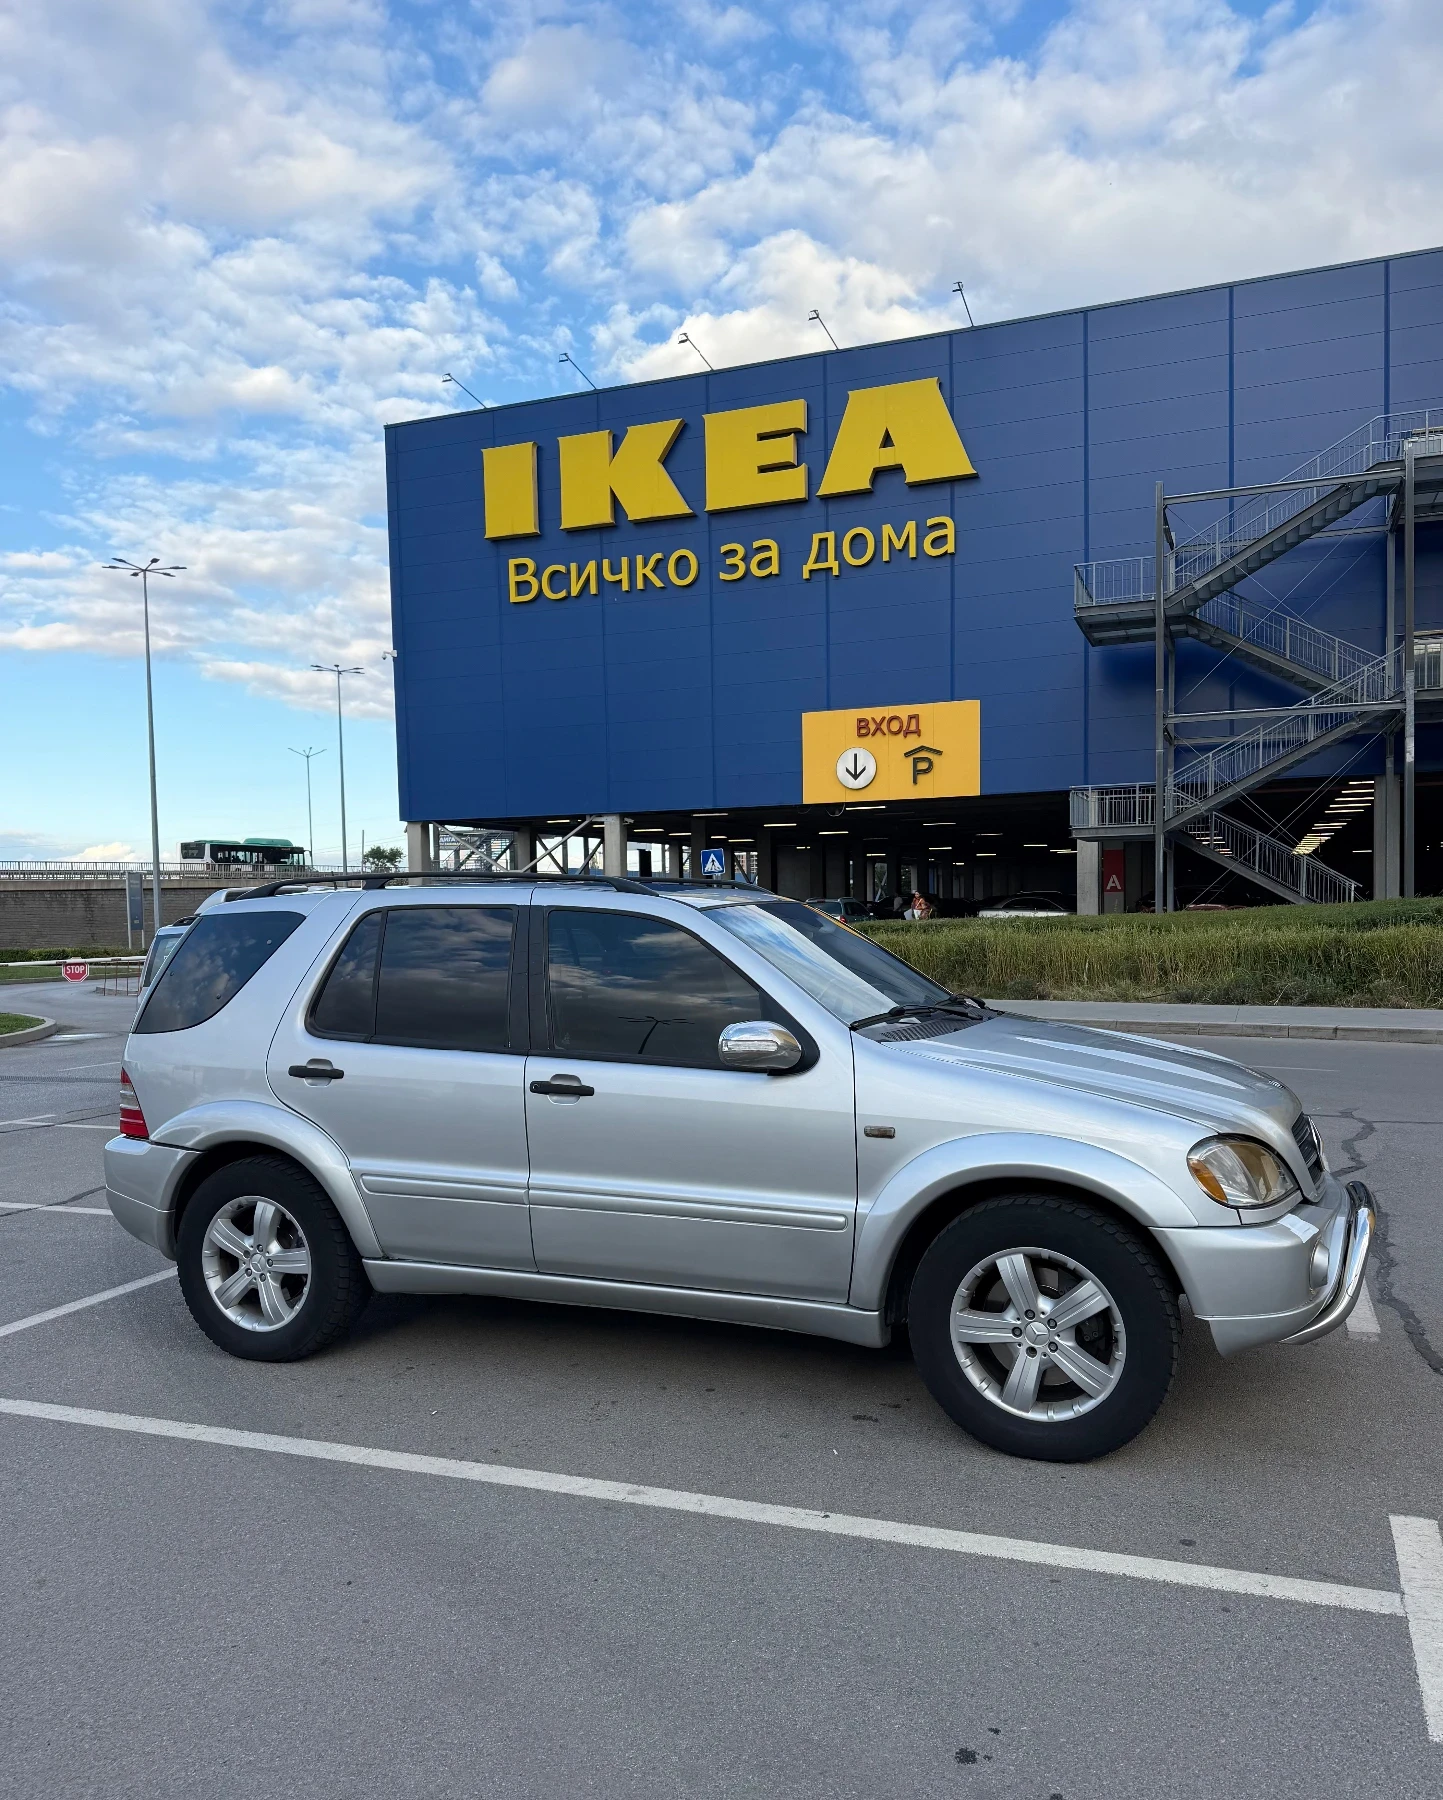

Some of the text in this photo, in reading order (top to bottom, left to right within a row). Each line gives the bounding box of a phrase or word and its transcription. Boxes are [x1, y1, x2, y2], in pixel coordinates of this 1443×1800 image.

[481, 377, 978, 540] IKEA
[508, 514, 957, 604] Всичко за дома
[856, 713, 922, 739] ВХОД
[912, 756, 934, 785] P
[1106, 874, 1122, 890] A
[66, 965, 85, 974] STOP
